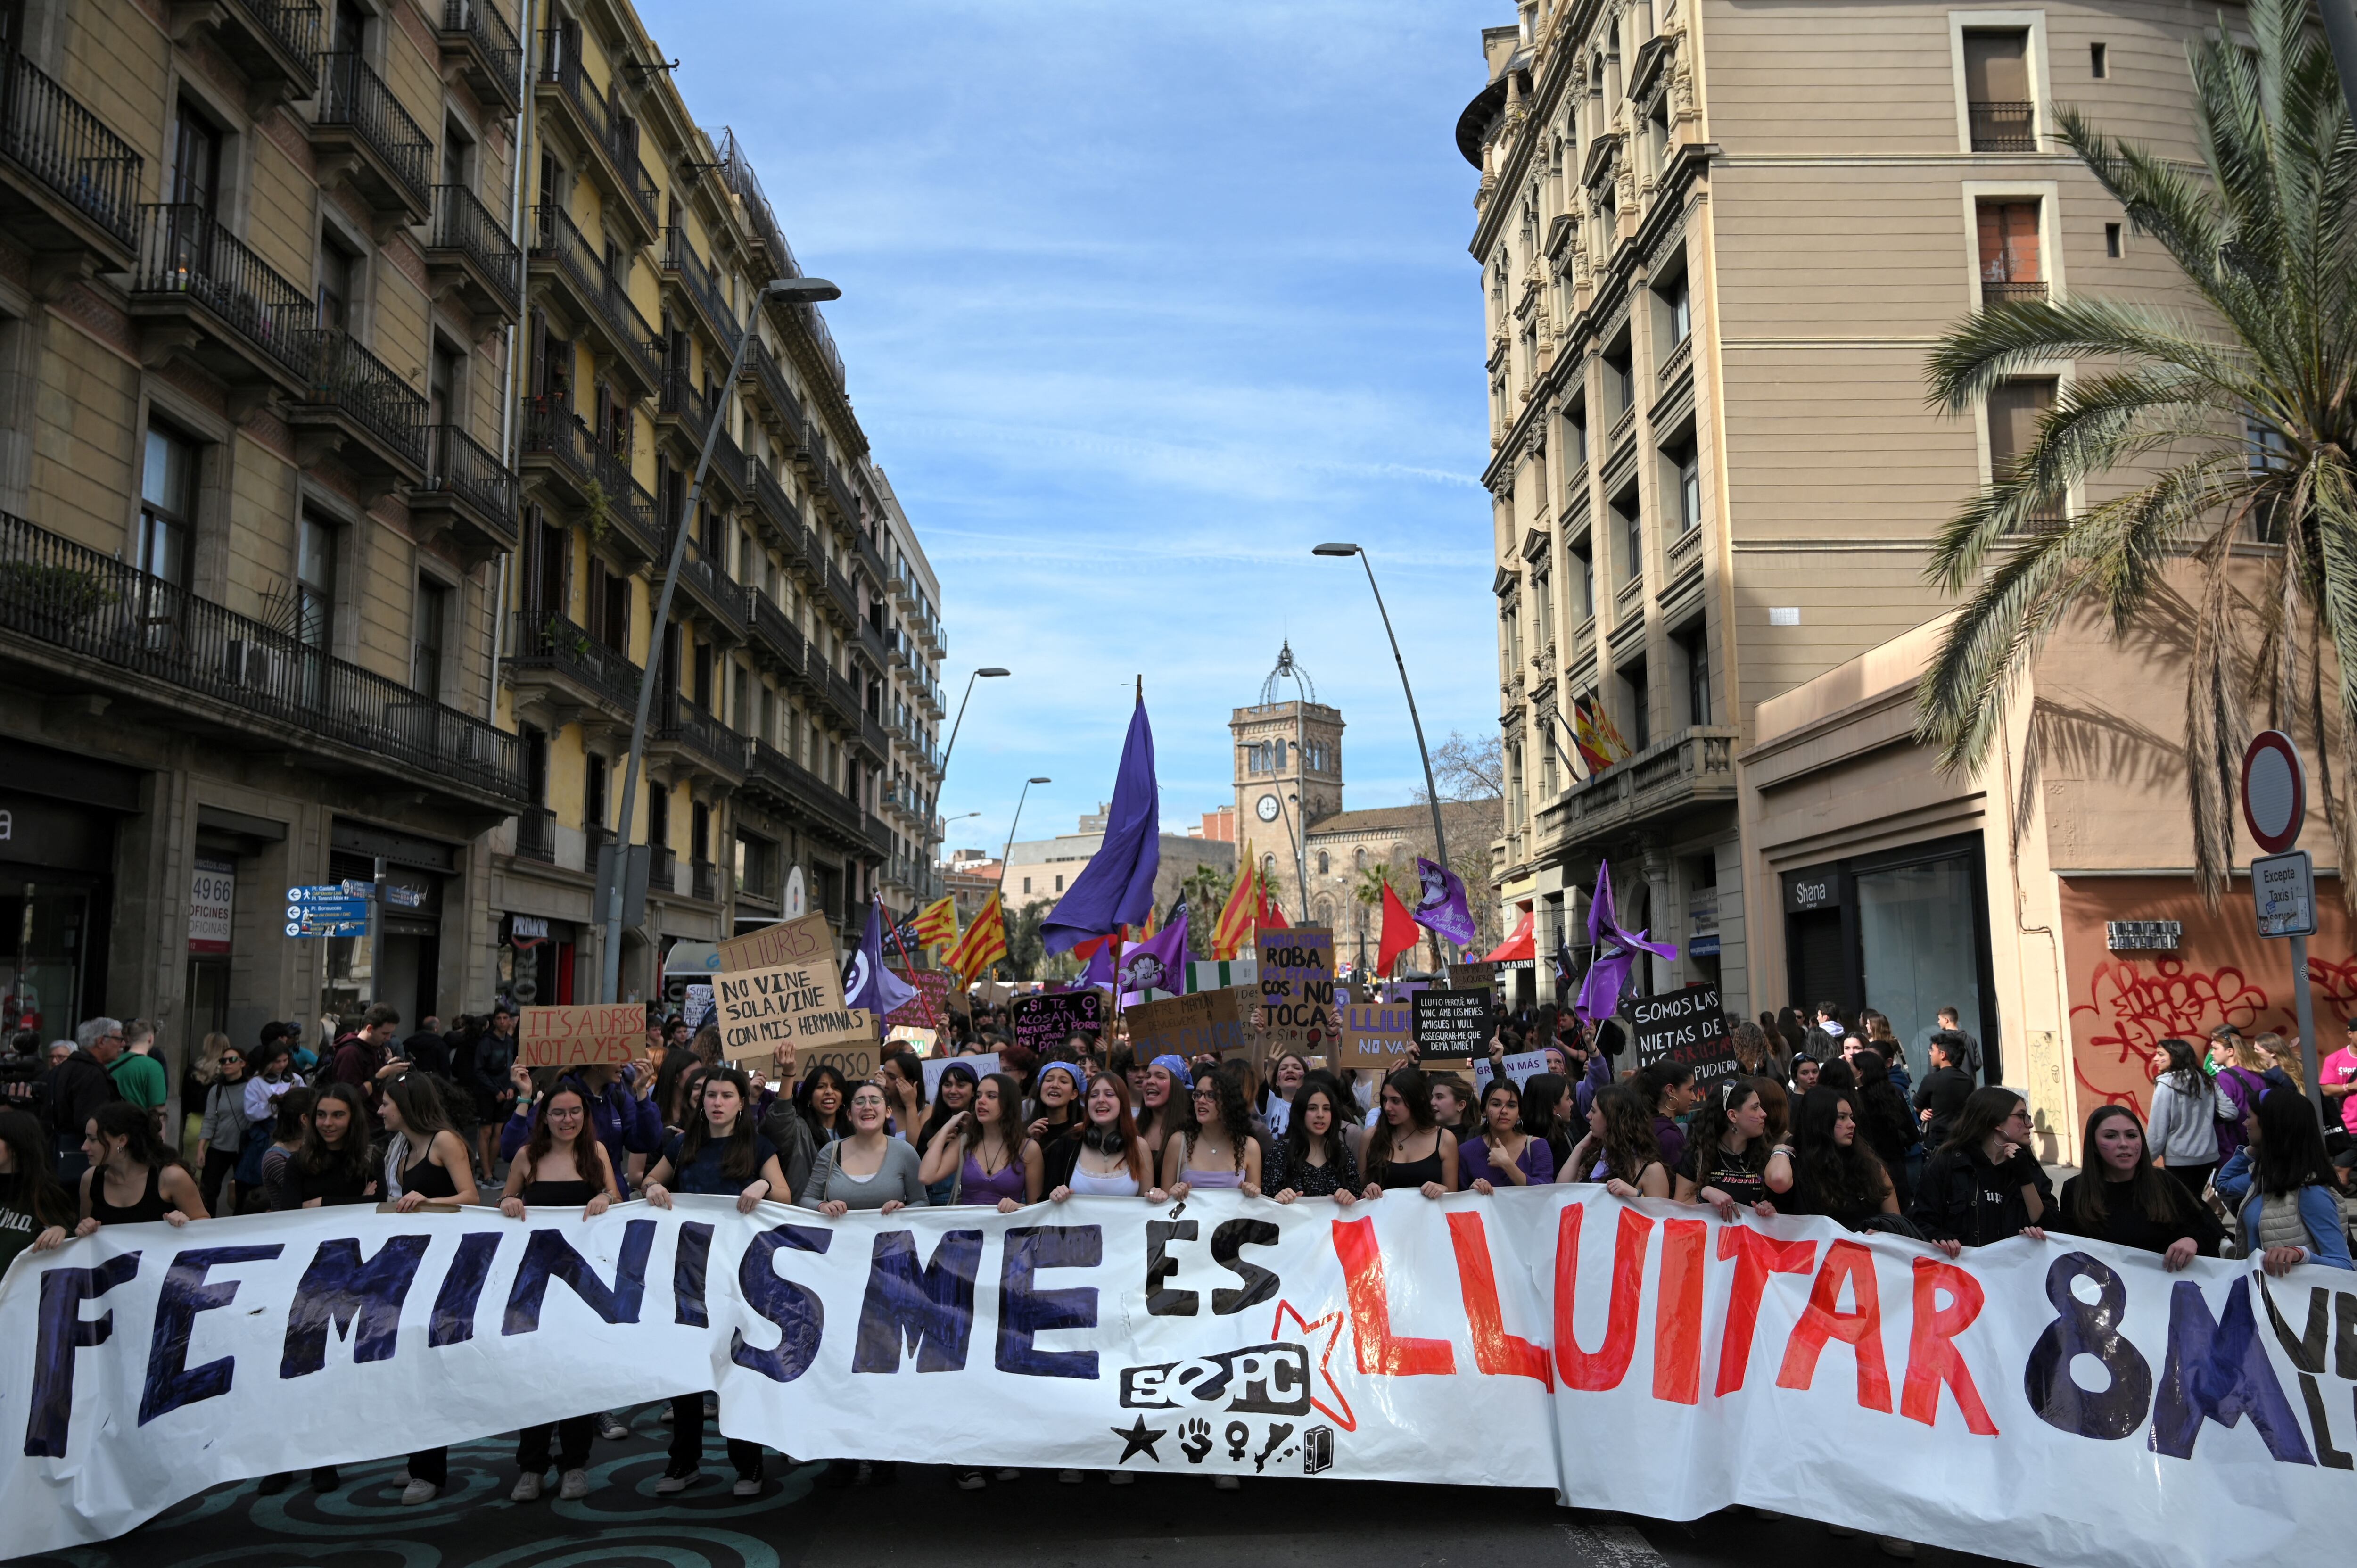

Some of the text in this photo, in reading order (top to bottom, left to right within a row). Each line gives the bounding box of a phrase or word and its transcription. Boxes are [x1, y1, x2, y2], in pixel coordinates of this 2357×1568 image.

[2264, 867, 2295, 883] Excepte
[1797, 883, 1825, 904] Shana
[2269, 889, 2290, 903] Taxis
[1266, 946, 1324, 970] ROBA,
[721, 970, 811, 1003] NO VINE
[1467, 974, 1493, 983] QUIERO
[1261, 980, 1290, 997] COS
[1304, 981, 1334, 1005] NO
[1421, 998, 1443, 1007] LLUITO
[1466, 997, 1478, 1005] AVUI
[1050, 999, 1067, 1009] TE
[1136, 1001, 1175, 1019] SUFRE
[1420, 1007, 1483, 1017] VINC AMB LES MEVES
[1635, 991, 1719, 1023] SOMOS LAS
[527, 1007, 645, 1038] IT'S A DRESS
[760, 1018, 793, 1041] MIS
[798, 1009, 864, 1036] HERMANAS
[1261, 1003, 1328, 1027] TOCA
[1422, 1019, 1450, 1030] AMIGUES
[1457, 1019, 1474, 1029] VULL
[1017, 1023, 1053, 1035] PRENDE
[1071, 1021, 1102, 1030] PORRO
[1420, 1031, 1481, 1041] ASSEGURAR-ME QUE
[1640, 1018, 1722, 1052] NIETAS DE
[526, 1036, 633, 1066] NOT A YES
[1136, 1032, 1175, 1064] MIS
[1359, 1038, 1381, 1055] NO
[1673, 1035, 1732, 1064] BRUJAS
[1517, 1058, 1540, 1071] MÁS
[24, 1201, 2318, 1467] FEMINISME ÉS LLUITAR 8M
